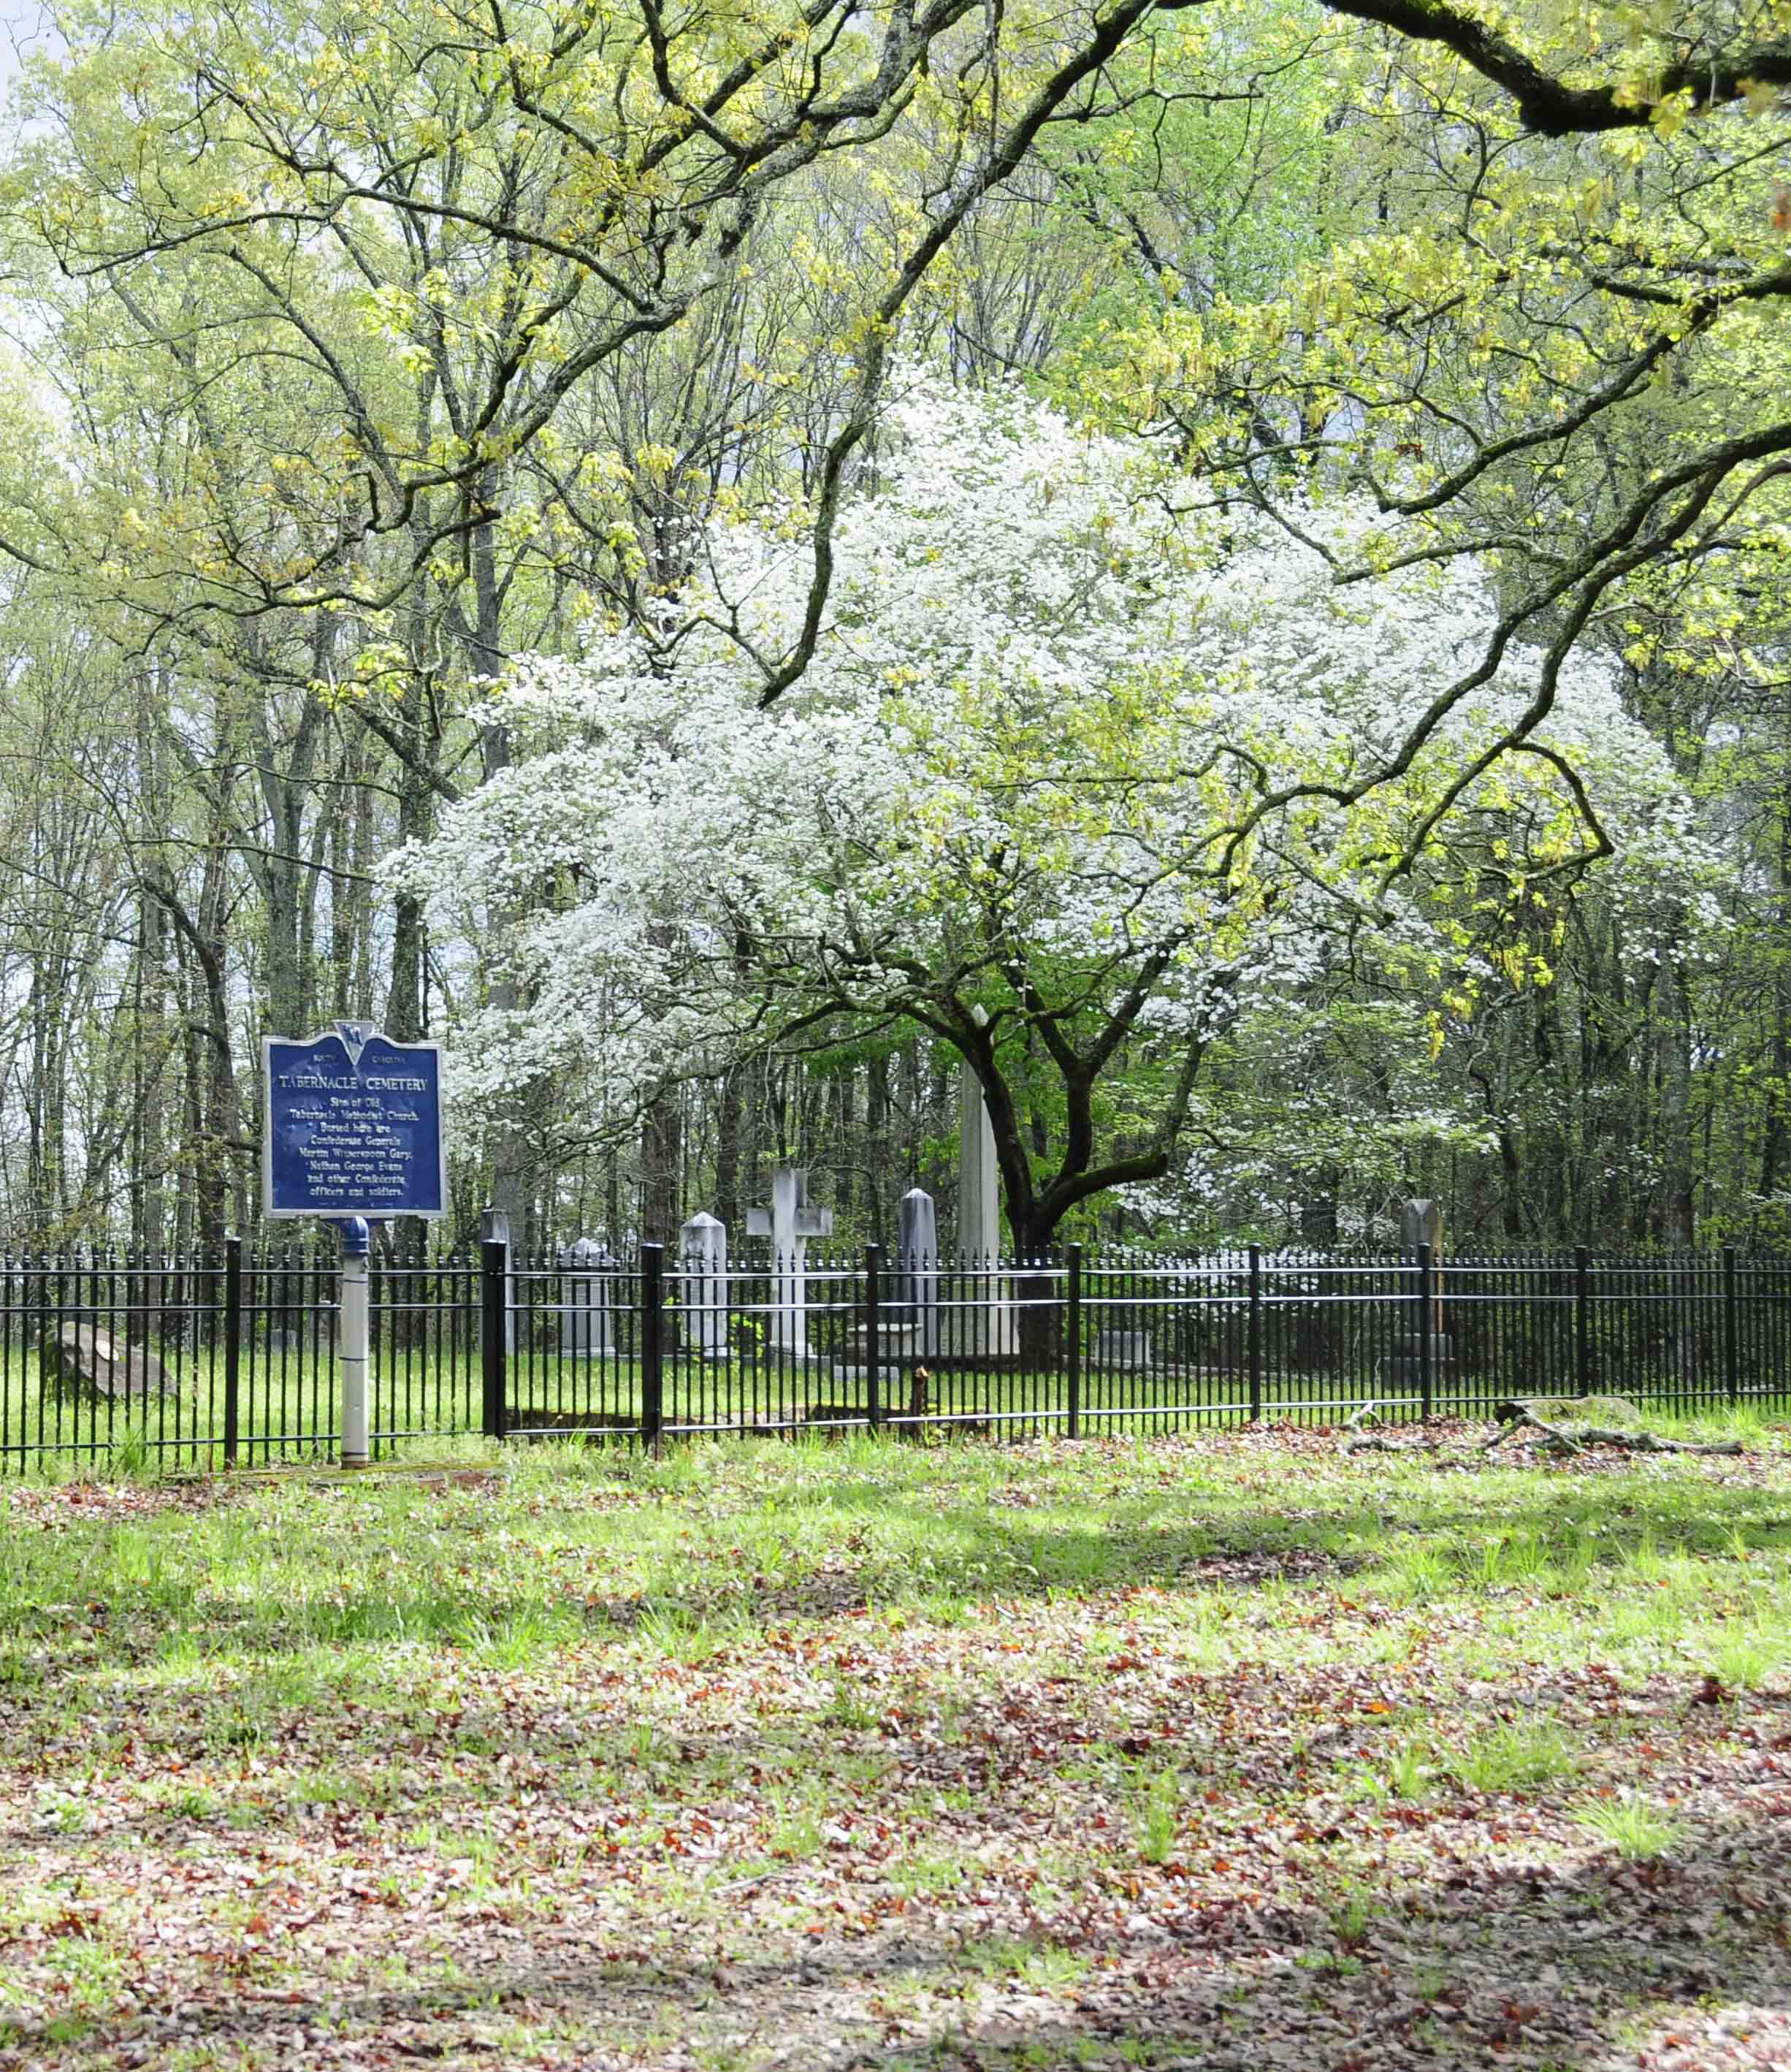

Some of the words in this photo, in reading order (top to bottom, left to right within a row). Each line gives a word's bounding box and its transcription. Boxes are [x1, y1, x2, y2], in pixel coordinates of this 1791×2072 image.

[279, 1075, 357, 1089] TABERNACLE
[366, 1077, 428, 1092] CEMETERY
[351, 1097, 362, 1107] of
[353, 1122, 373, 1132] here
[310, 1161, 340, 1170] Nathan
[344, 1161, 374, 1172] George
[378, 1161, 402, 1171] Evans
[308, 1174, 324, 1184] and
[327, 1174, 351, 1184] other
[309, 1187, 344, 1197] officers
[348, 1188, 364, 1197] and
